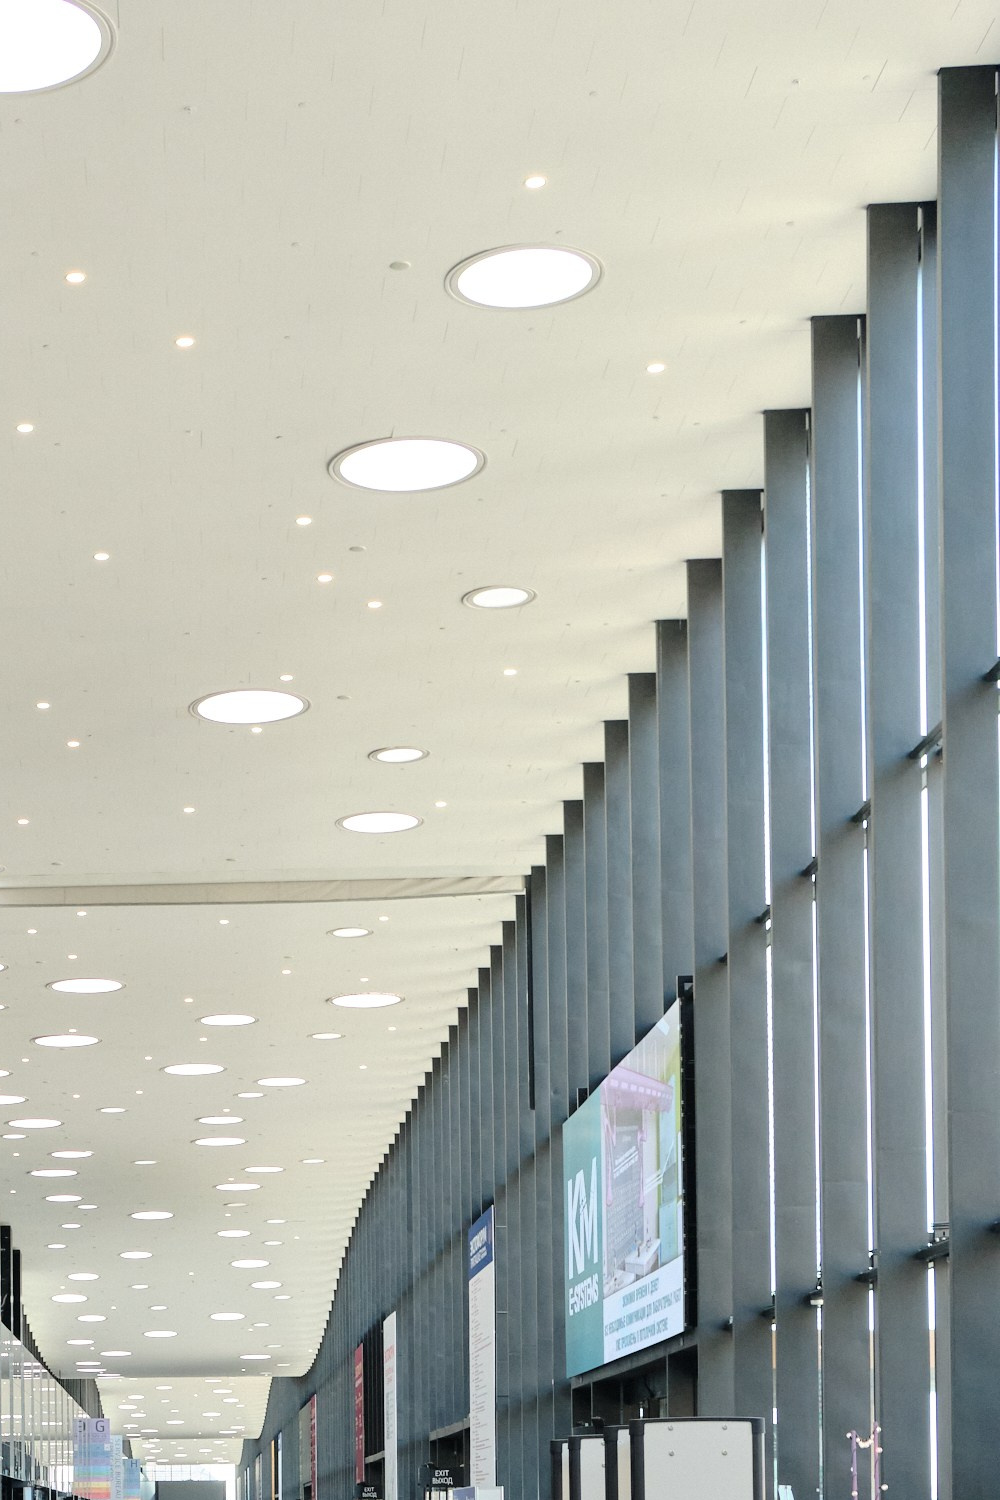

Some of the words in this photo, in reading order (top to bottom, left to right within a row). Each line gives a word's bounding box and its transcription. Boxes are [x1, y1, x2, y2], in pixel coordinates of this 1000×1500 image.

[95, 1420, 105, 1433] G
[130, 1460, 138, 1468] H
[435, 1469, 450, 1477] EXIT
[432, 1477, 453, 1485] ВЫХОД
